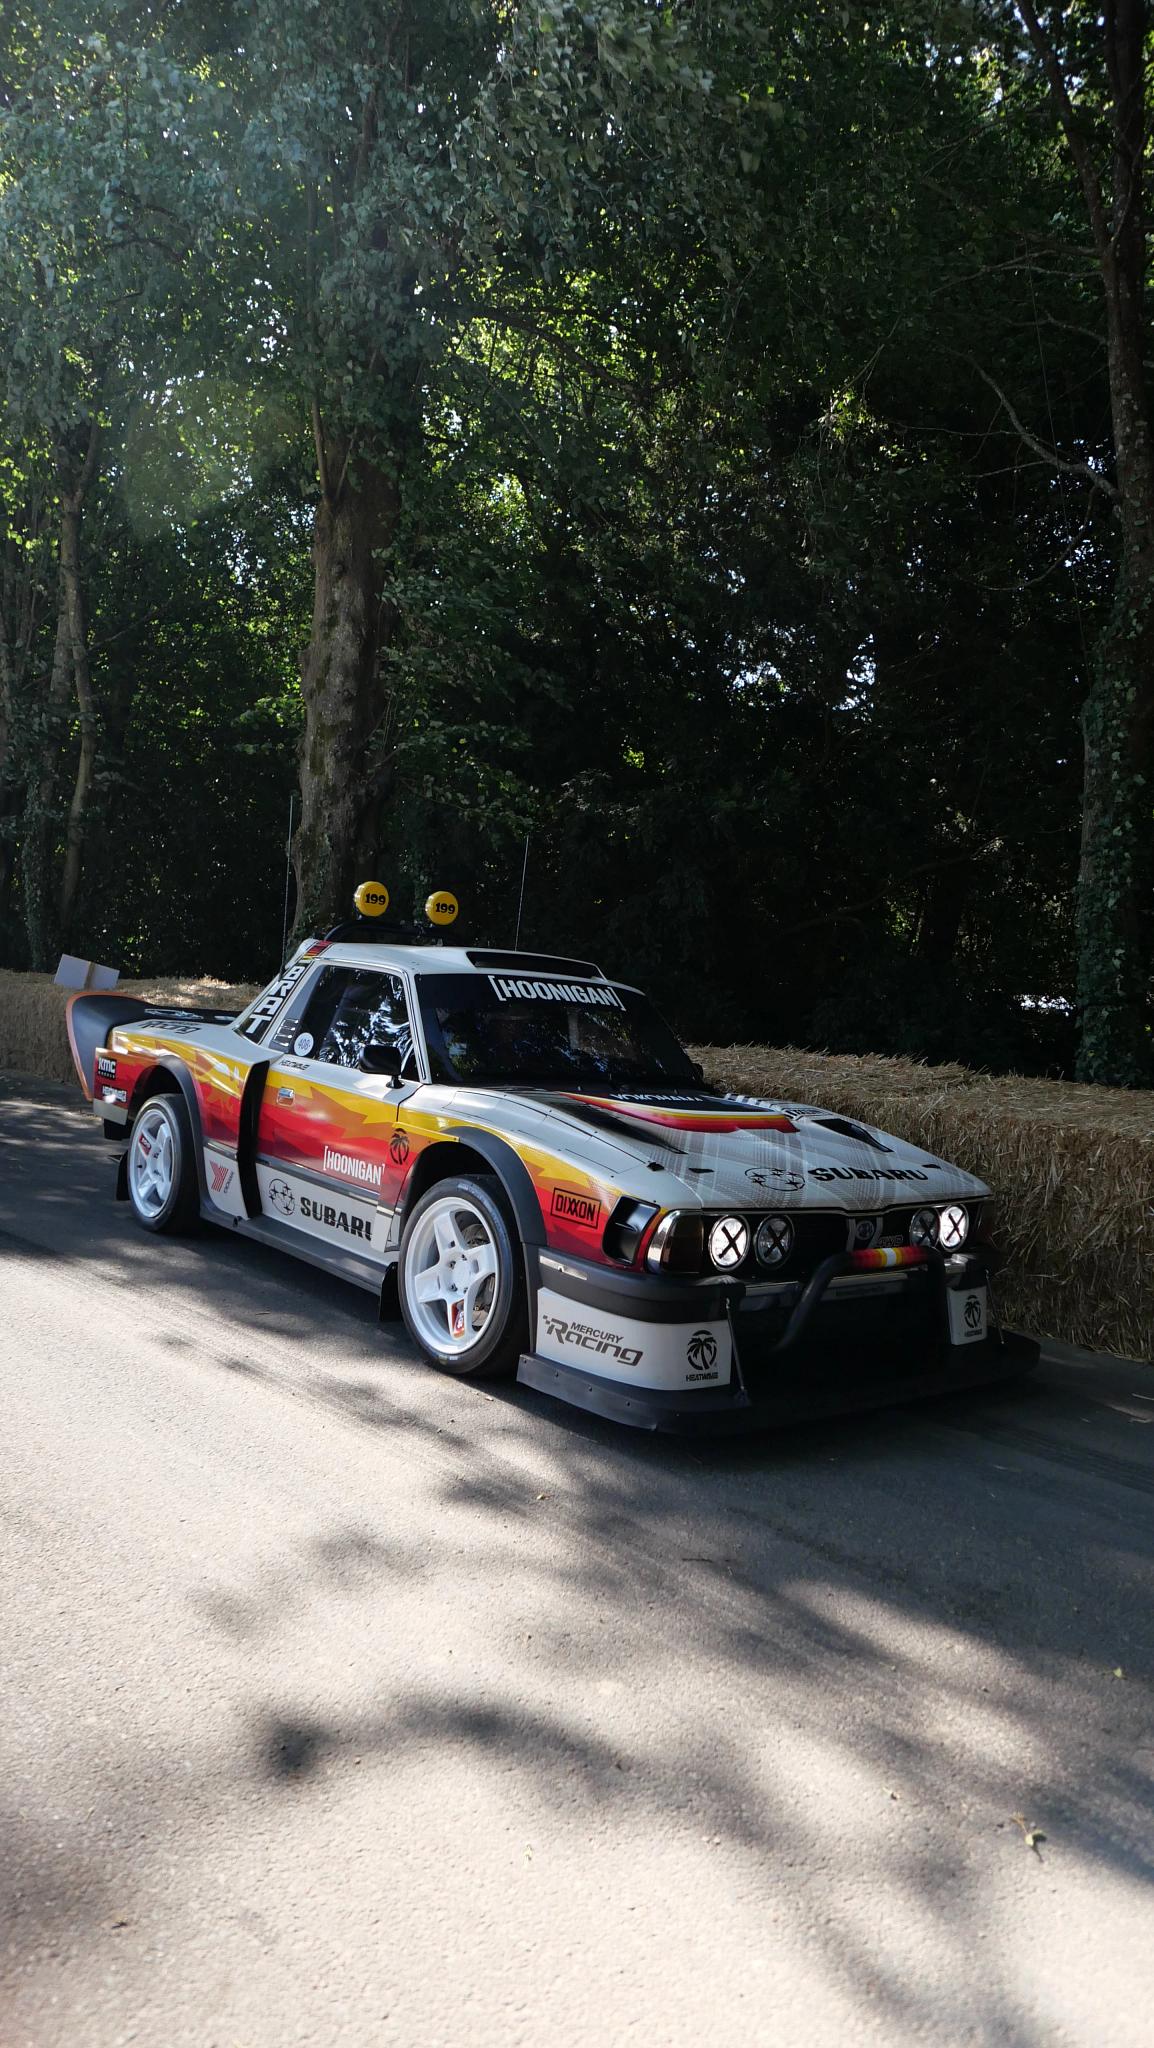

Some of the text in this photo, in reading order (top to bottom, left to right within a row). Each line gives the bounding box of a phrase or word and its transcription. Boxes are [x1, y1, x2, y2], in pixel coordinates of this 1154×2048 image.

[365, 893, 386, 905] 199
[435, 902, 455, 914] 199
[246, 965, 306, 1034] BRAT
[807, 1167, 929, 1181] SUBARU
[555, 1193, 596, 1222] DIXXON
[546, 1317, 644, 1367] Racing
[570, 1321, 624, 1343] MERCURY
